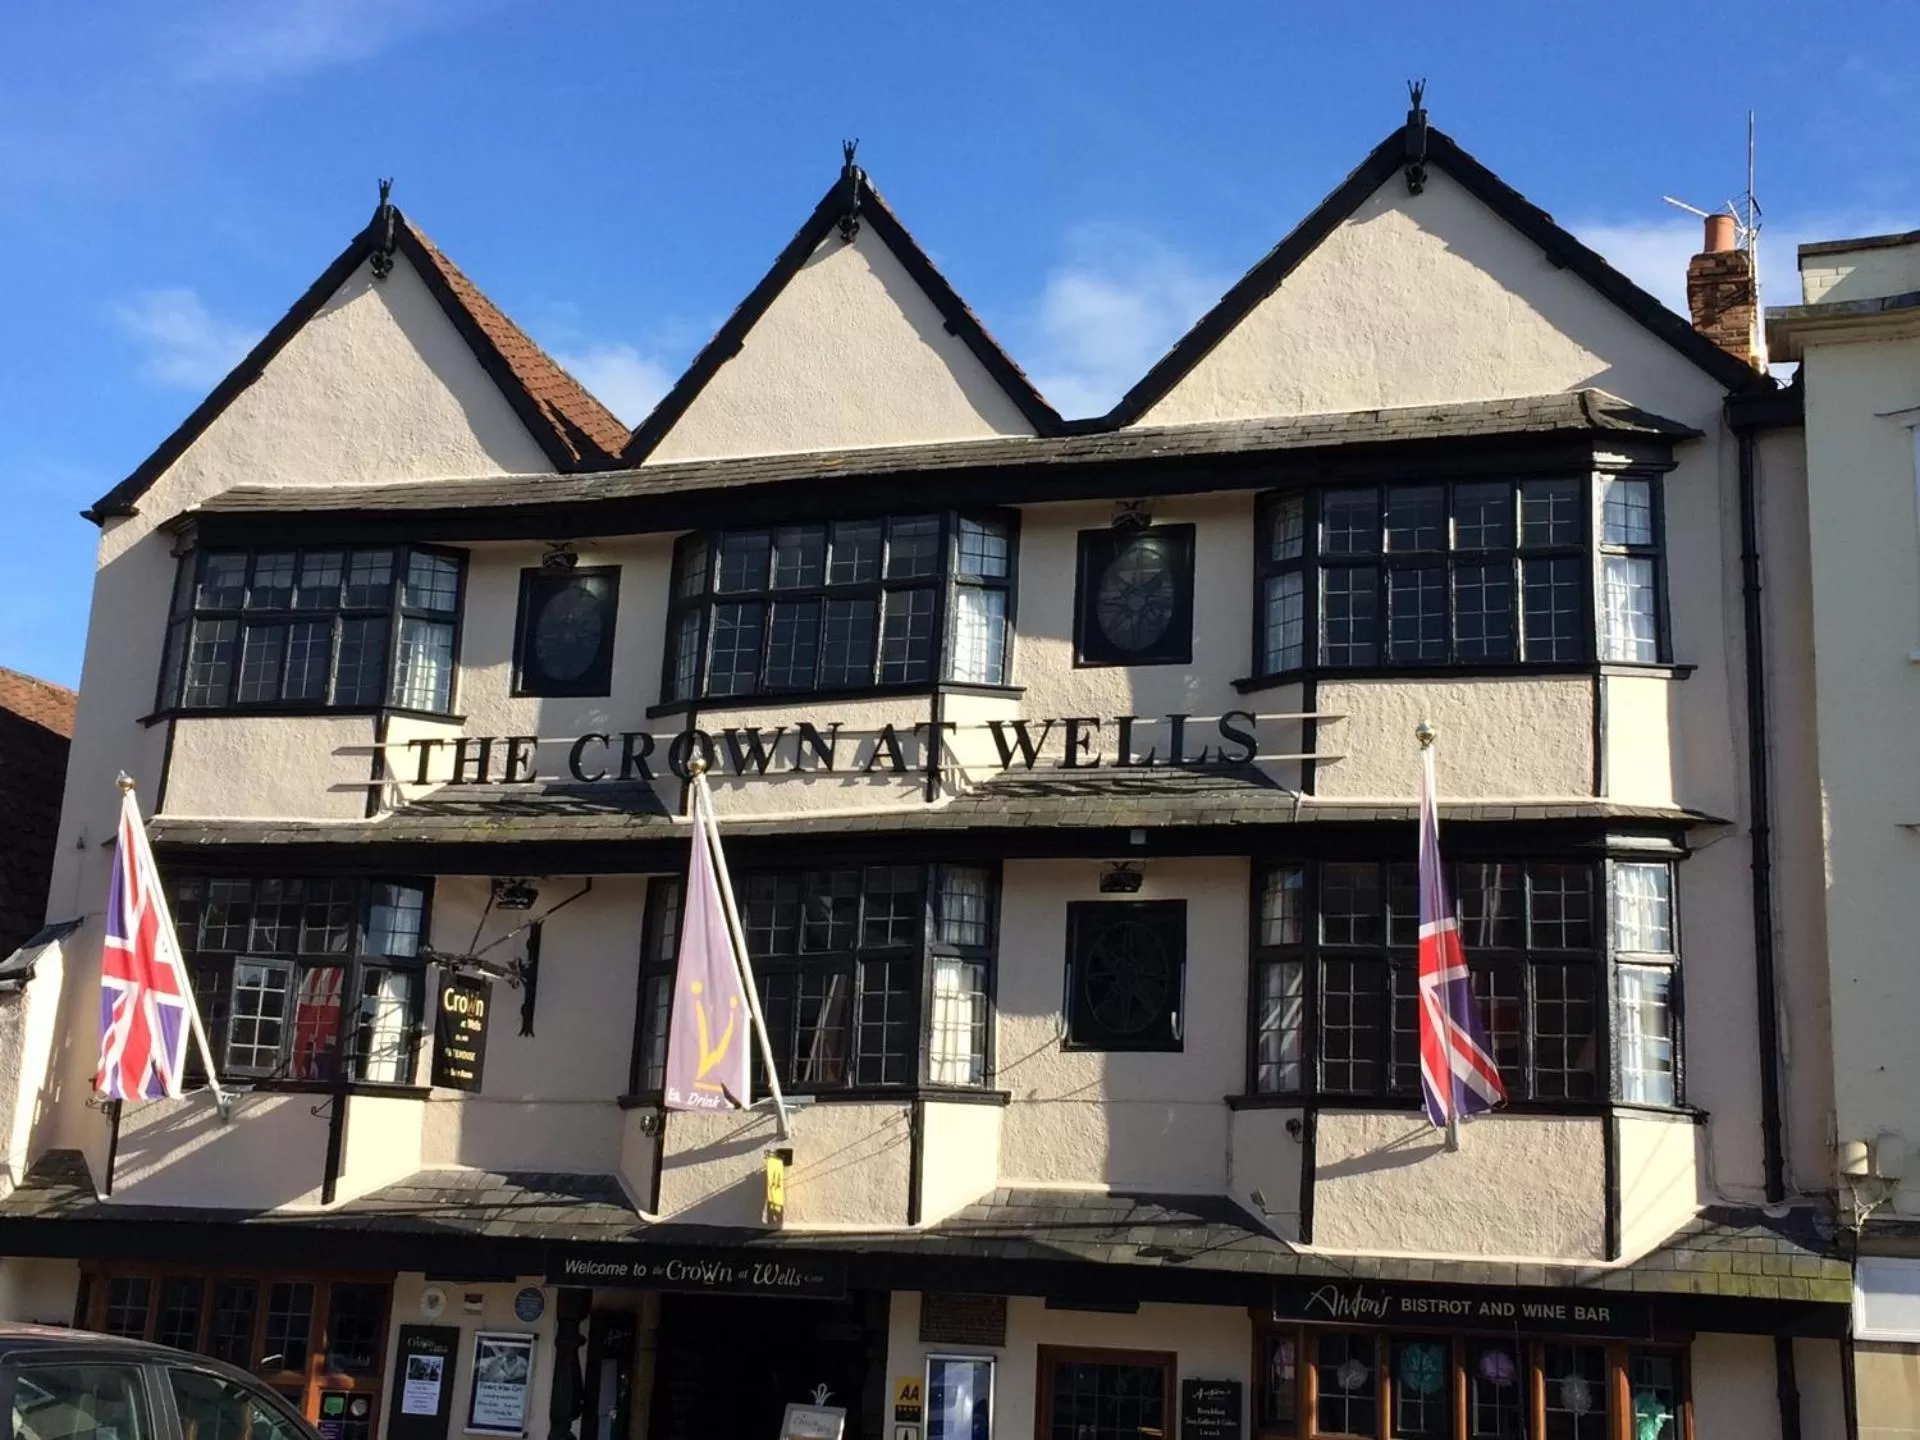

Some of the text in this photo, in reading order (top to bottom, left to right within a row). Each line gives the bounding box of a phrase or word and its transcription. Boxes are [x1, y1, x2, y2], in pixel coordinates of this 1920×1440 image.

[408, 711, 1258, 785] THE CROWN AT WELLS
[565, 1259, 628, 1277] Welcome
[632, 1262, 647, 1277] to
[753, 1263, 801, 1286] Wells
[1401, 1298, 1472, 1315] BISTROT
[1479, 1302, 1515, 1317] AND
[1522, 1303, 1566, 1320] WINE
[1574, 1306, 1610, 1322] BAR
[900, 1384, 919, 1400] AA
